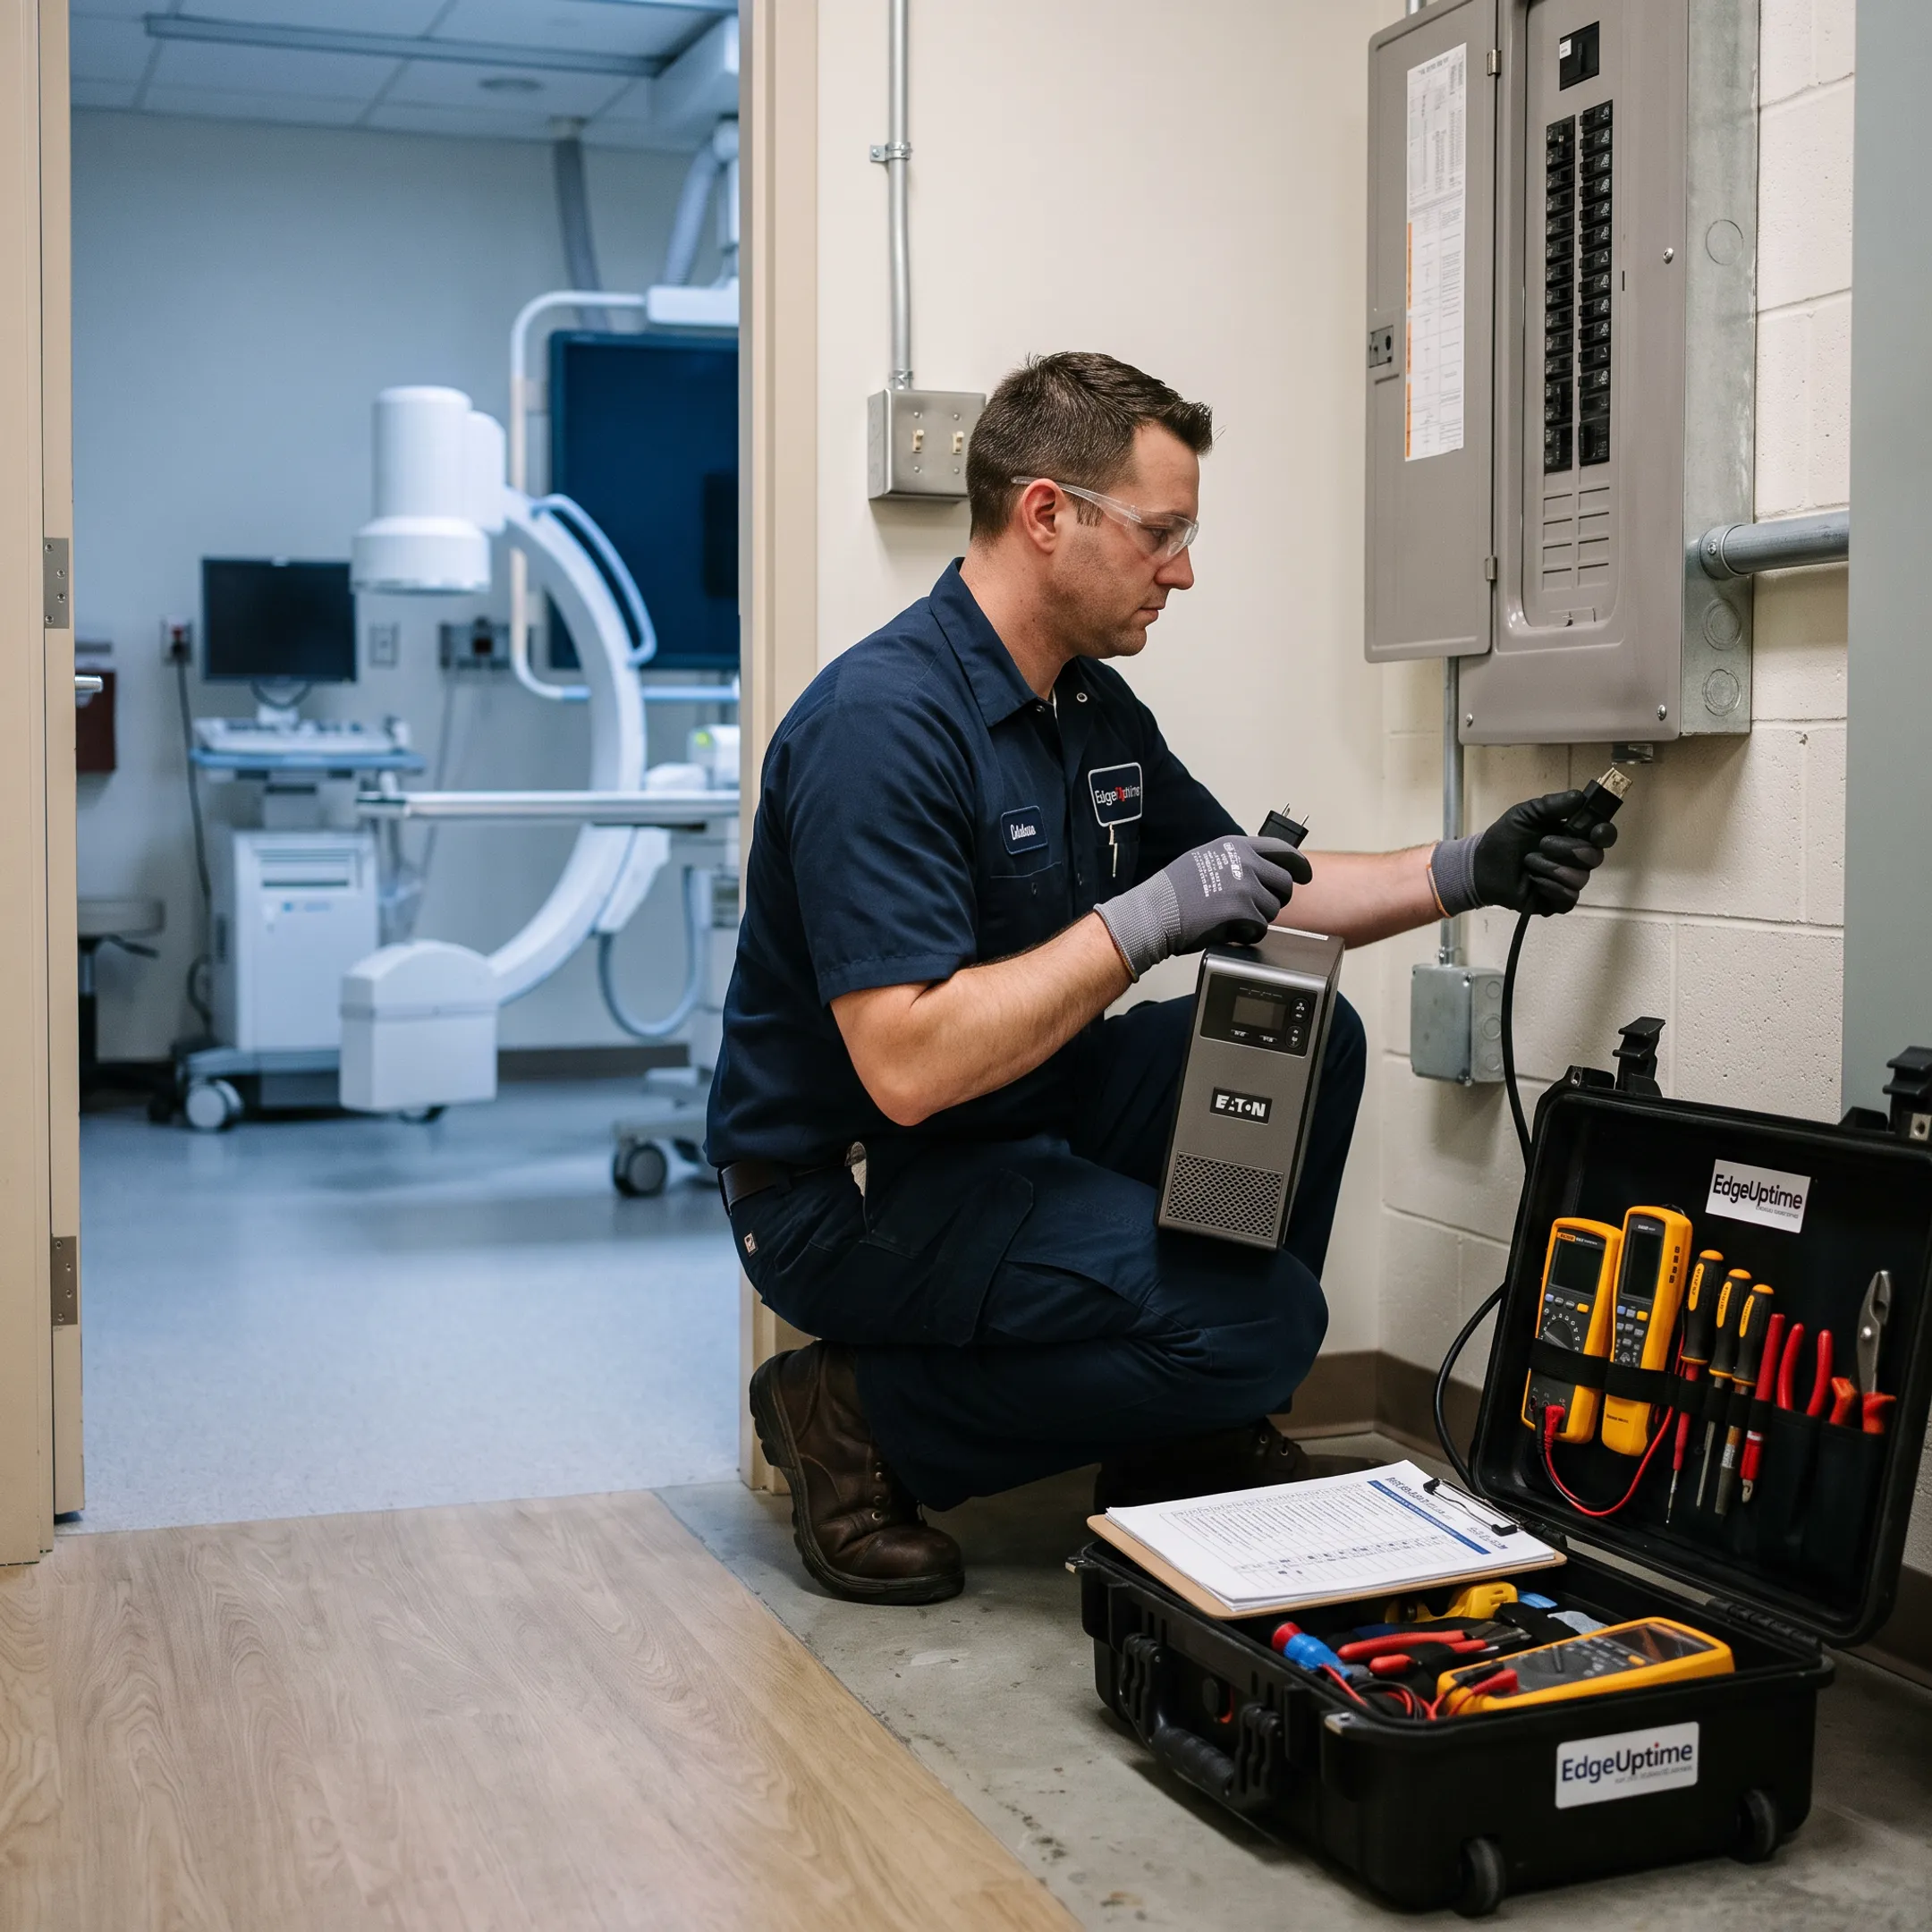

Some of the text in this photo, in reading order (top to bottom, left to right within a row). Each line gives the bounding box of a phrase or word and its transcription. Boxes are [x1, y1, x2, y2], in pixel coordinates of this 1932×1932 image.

[1215, 1094, 1267, 1117] EATON
[1712, 1174, 1803, 1209] EdgeUptime
[1562, 1741, 1693, 1784] EdgeUptime
